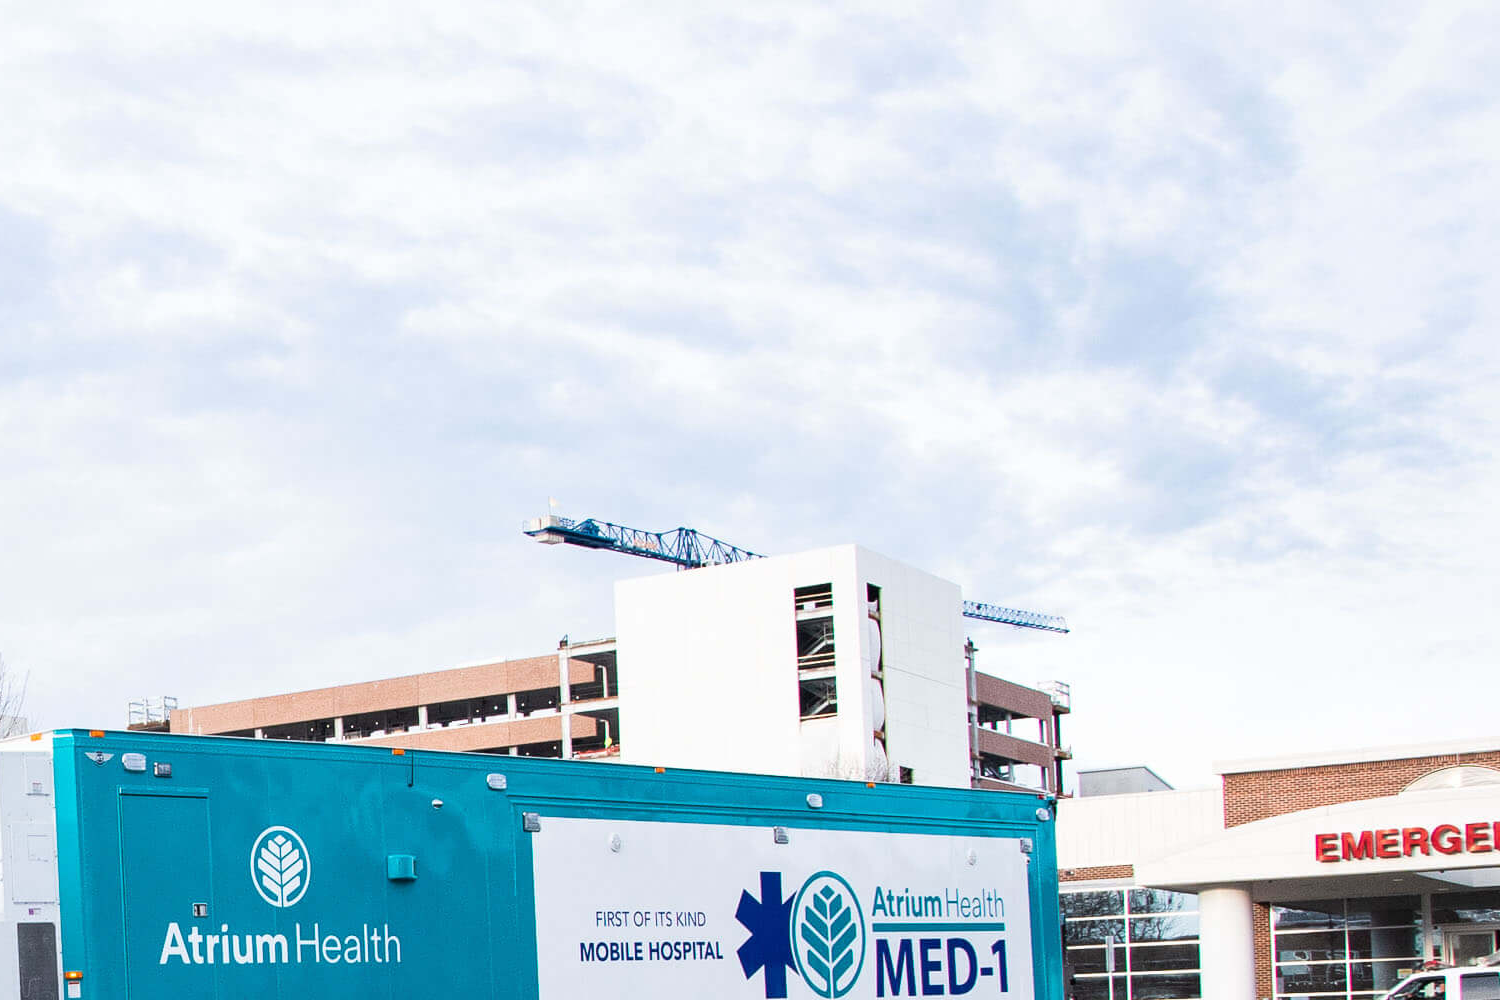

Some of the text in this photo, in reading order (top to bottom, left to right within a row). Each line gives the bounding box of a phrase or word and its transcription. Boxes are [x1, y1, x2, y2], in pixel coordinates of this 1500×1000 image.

[1315, 821, 1500, 863] EMERGE
[595, 911, 706, 927] FIRST OF ITS KIND
[872, 886, 1004, 918] Atrium Health
[159, 922, 401, 964] Atrium Health
[579, 941, 724, 961] MOBILE HOSPITAL
[875, 937, 1008, 998] MED-1
